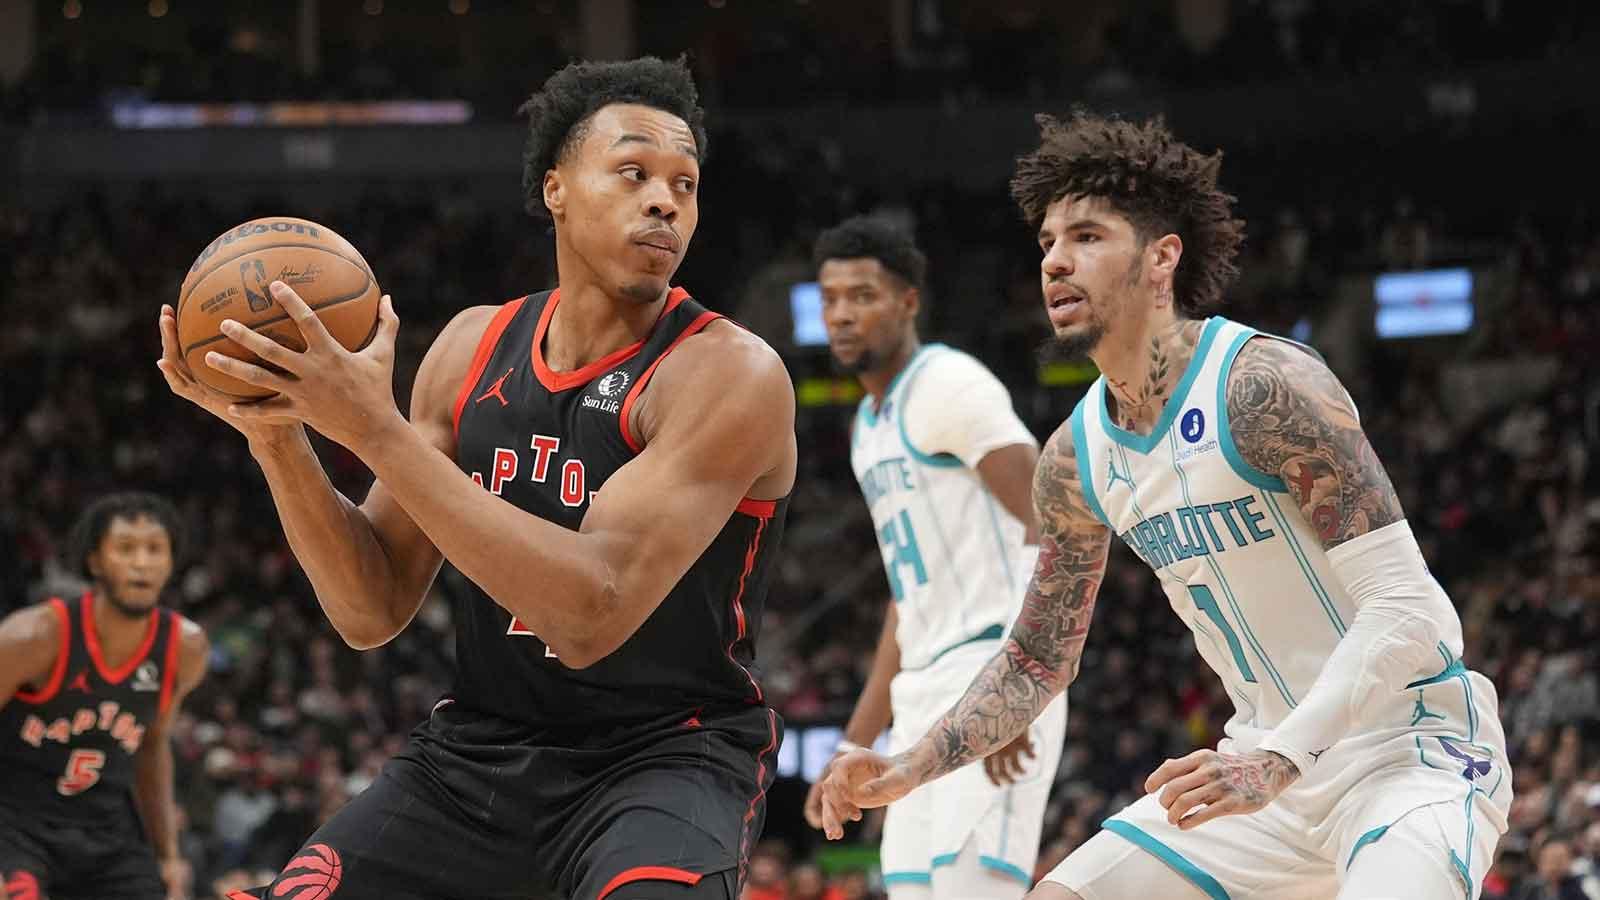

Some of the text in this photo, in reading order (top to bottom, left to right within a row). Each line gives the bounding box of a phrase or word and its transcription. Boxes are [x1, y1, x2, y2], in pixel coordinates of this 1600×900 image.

[582, 395, 619, 414] Sun Life
[1187, 584, 1257, 683] 1
[56, 748, 106, 796] 5
